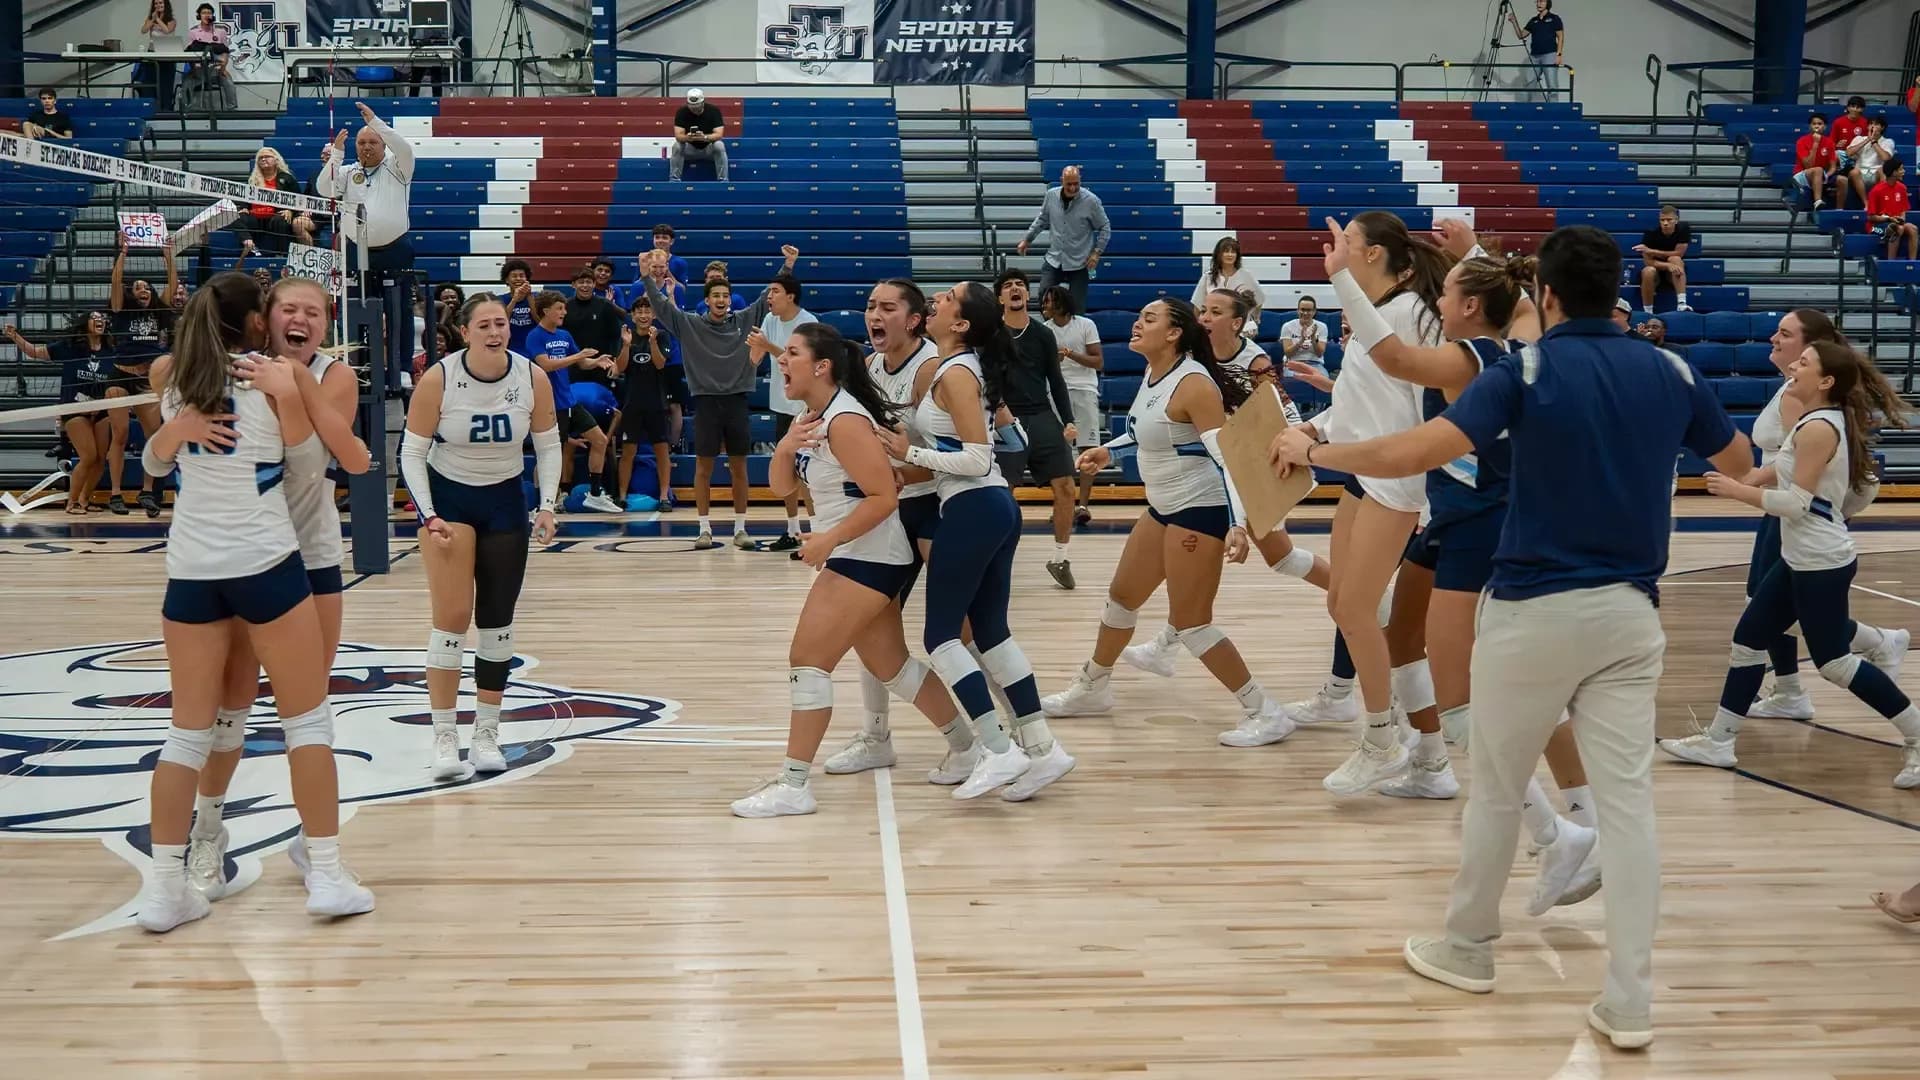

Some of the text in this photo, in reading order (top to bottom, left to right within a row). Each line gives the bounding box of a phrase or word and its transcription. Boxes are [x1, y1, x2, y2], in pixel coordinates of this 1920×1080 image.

[333, 18, 410, 32] SPOR
[899, 21, 1014, 35] SPORTS
[886, 38, 1027, 53] NETWORK
[0, 136, 17, 157] ATS
[469, 413, 513, 443] 20
